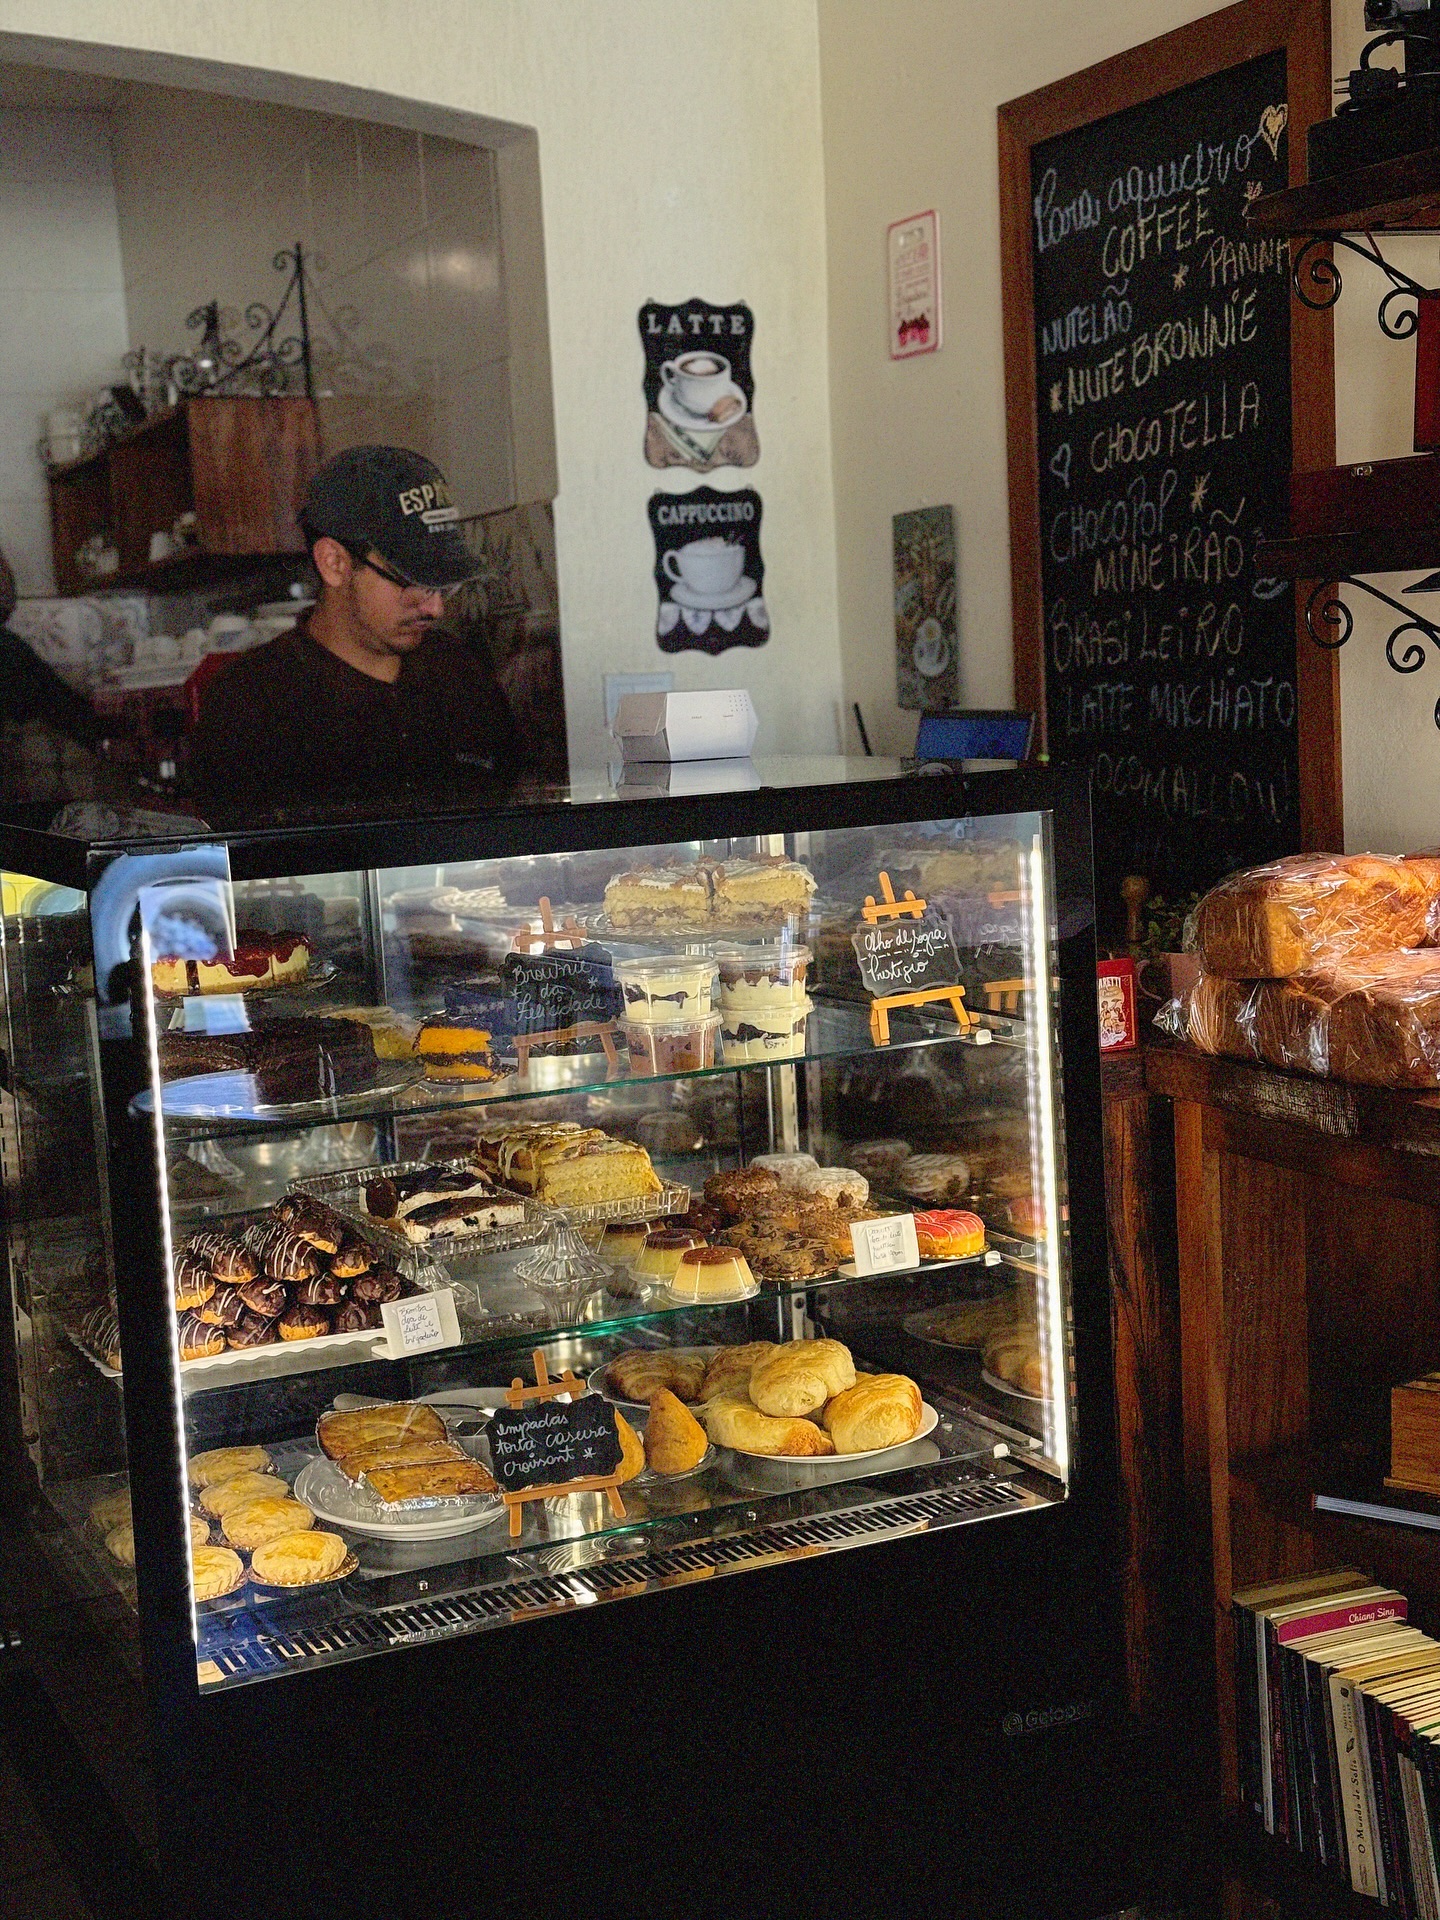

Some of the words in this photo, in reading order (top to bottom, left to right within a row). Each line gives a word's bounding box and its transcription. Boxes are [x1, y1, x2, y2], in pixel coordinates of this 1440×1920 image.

[1102, 187, 1214, 278] COFFEE
[646, 312, 747, 336] LATTE
[1042, 278, 1133, 356] NUTELÃO
[656, 501, 755, 526] CAPPUCCINO
[1095, 496, 1247, 597] MINEIRÃO
[1348, 1611, 1375, 1624] Chiang
[1376, 1607, 1396, 1618] Sing
[1352, 1789, 1361, 1800] de
[1353, 1803, 1365, 1840] Mundo
[1357, 1843, 1366, 1854] O
